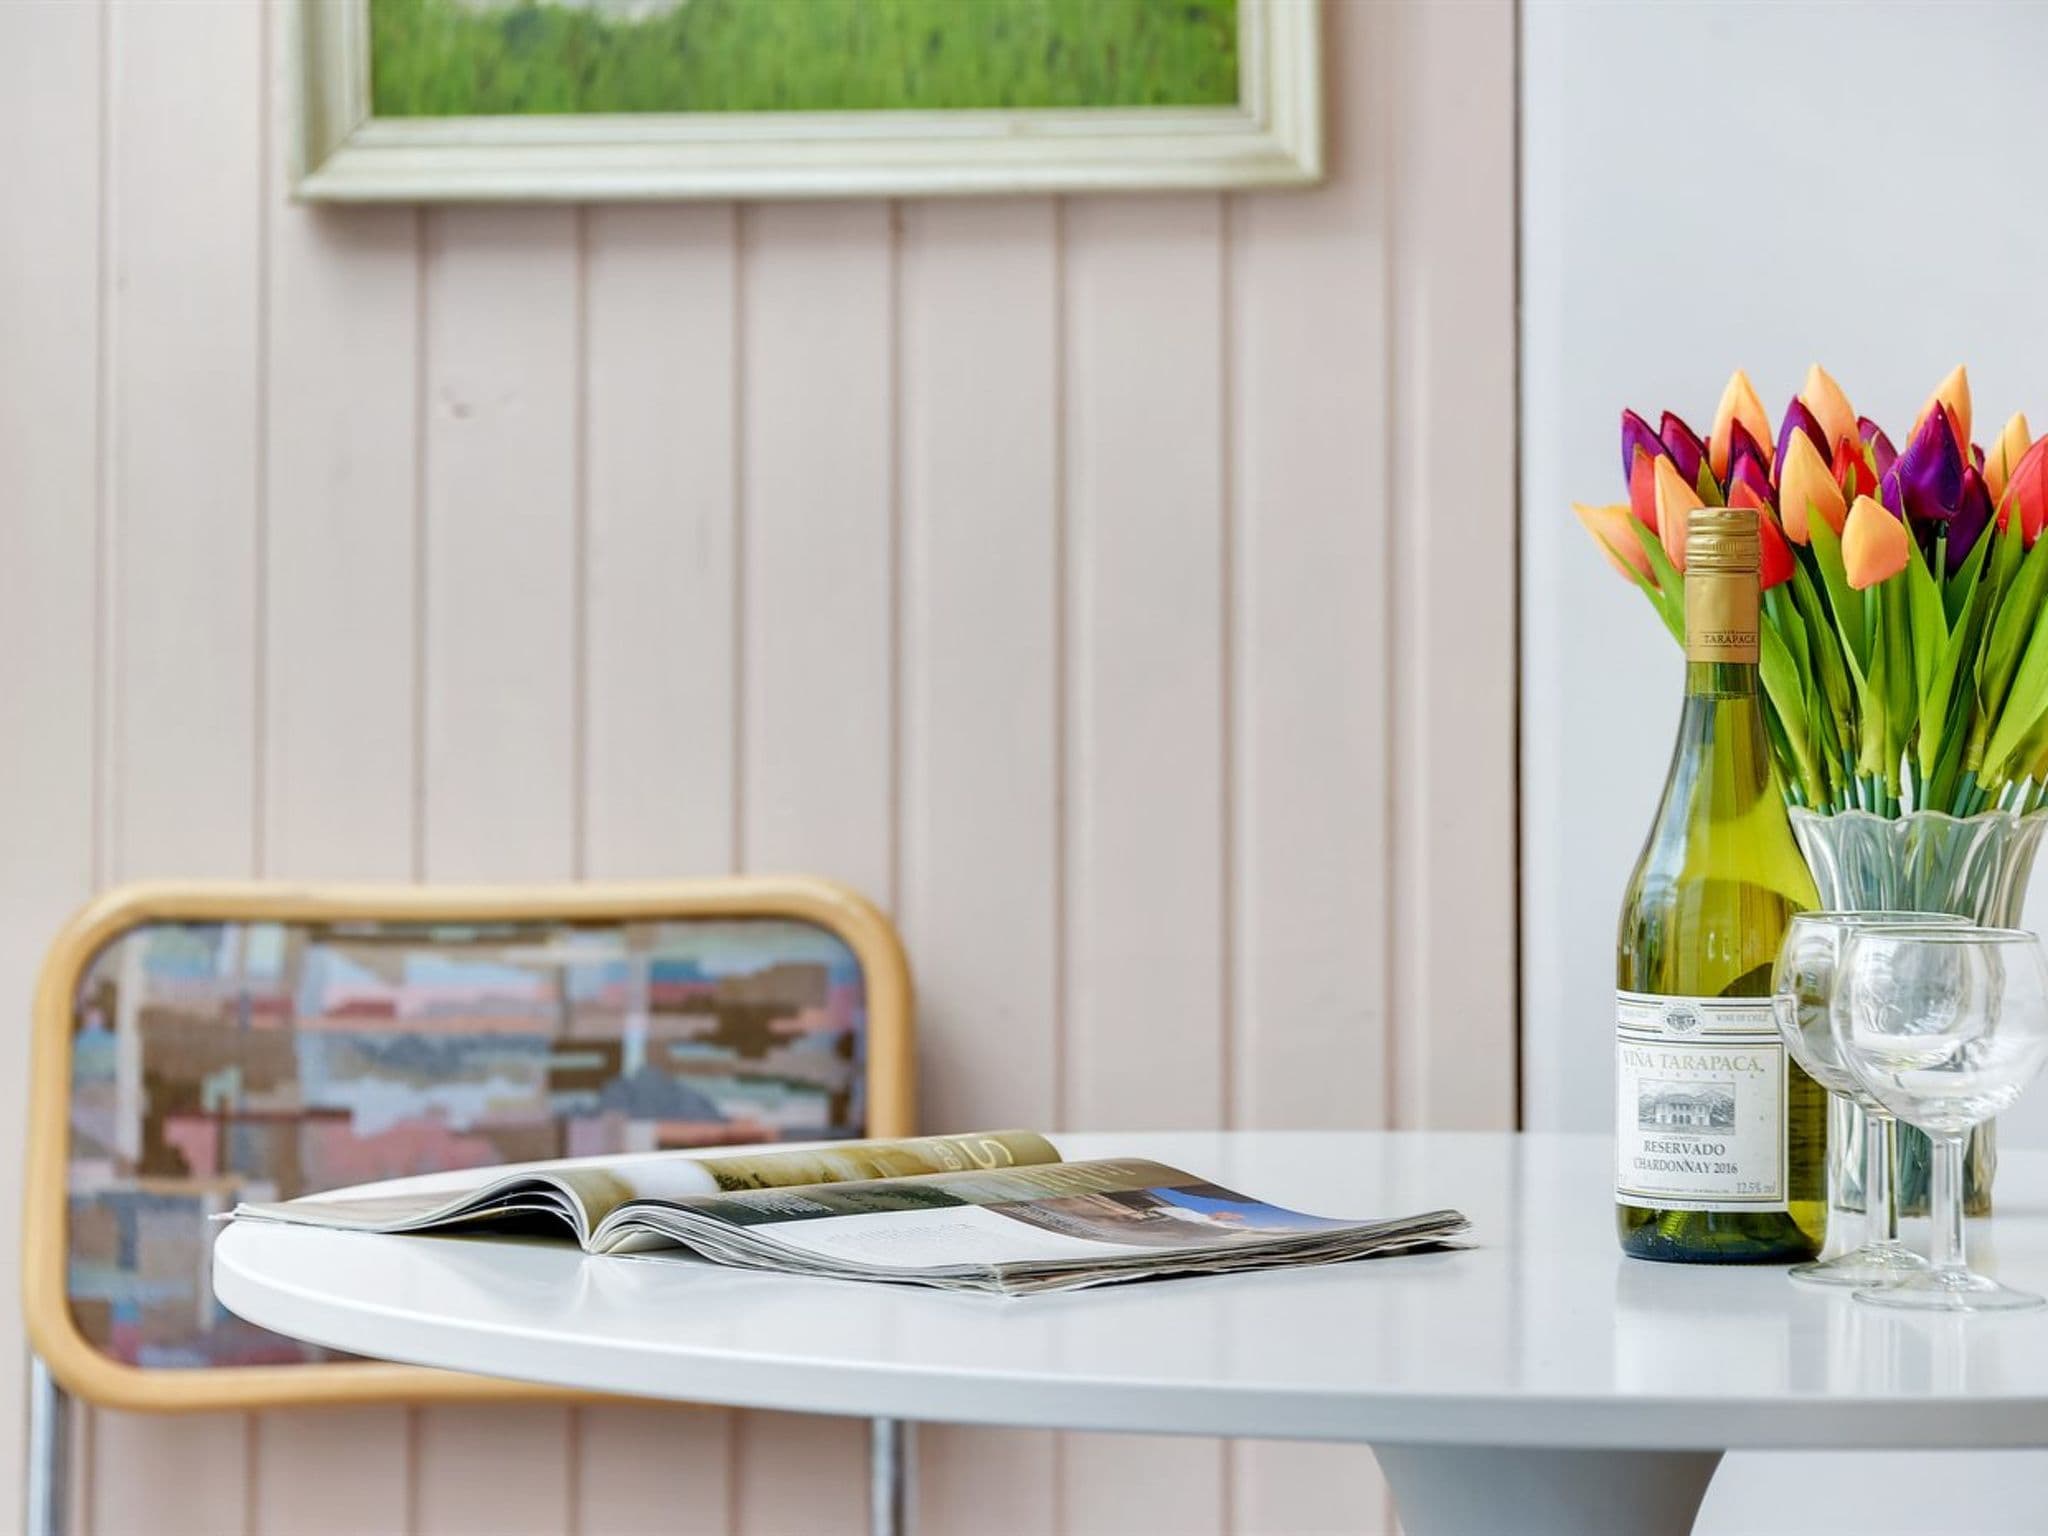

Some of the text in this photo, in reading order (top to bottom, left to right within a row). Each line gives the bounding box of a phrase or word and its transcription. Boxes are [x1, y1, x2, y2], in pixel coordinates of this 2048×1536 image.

[1643, 1140, 1726, 1156] RESERVADO
[1633, 1157, 1738, 1175] CHARDONNAY 2016
